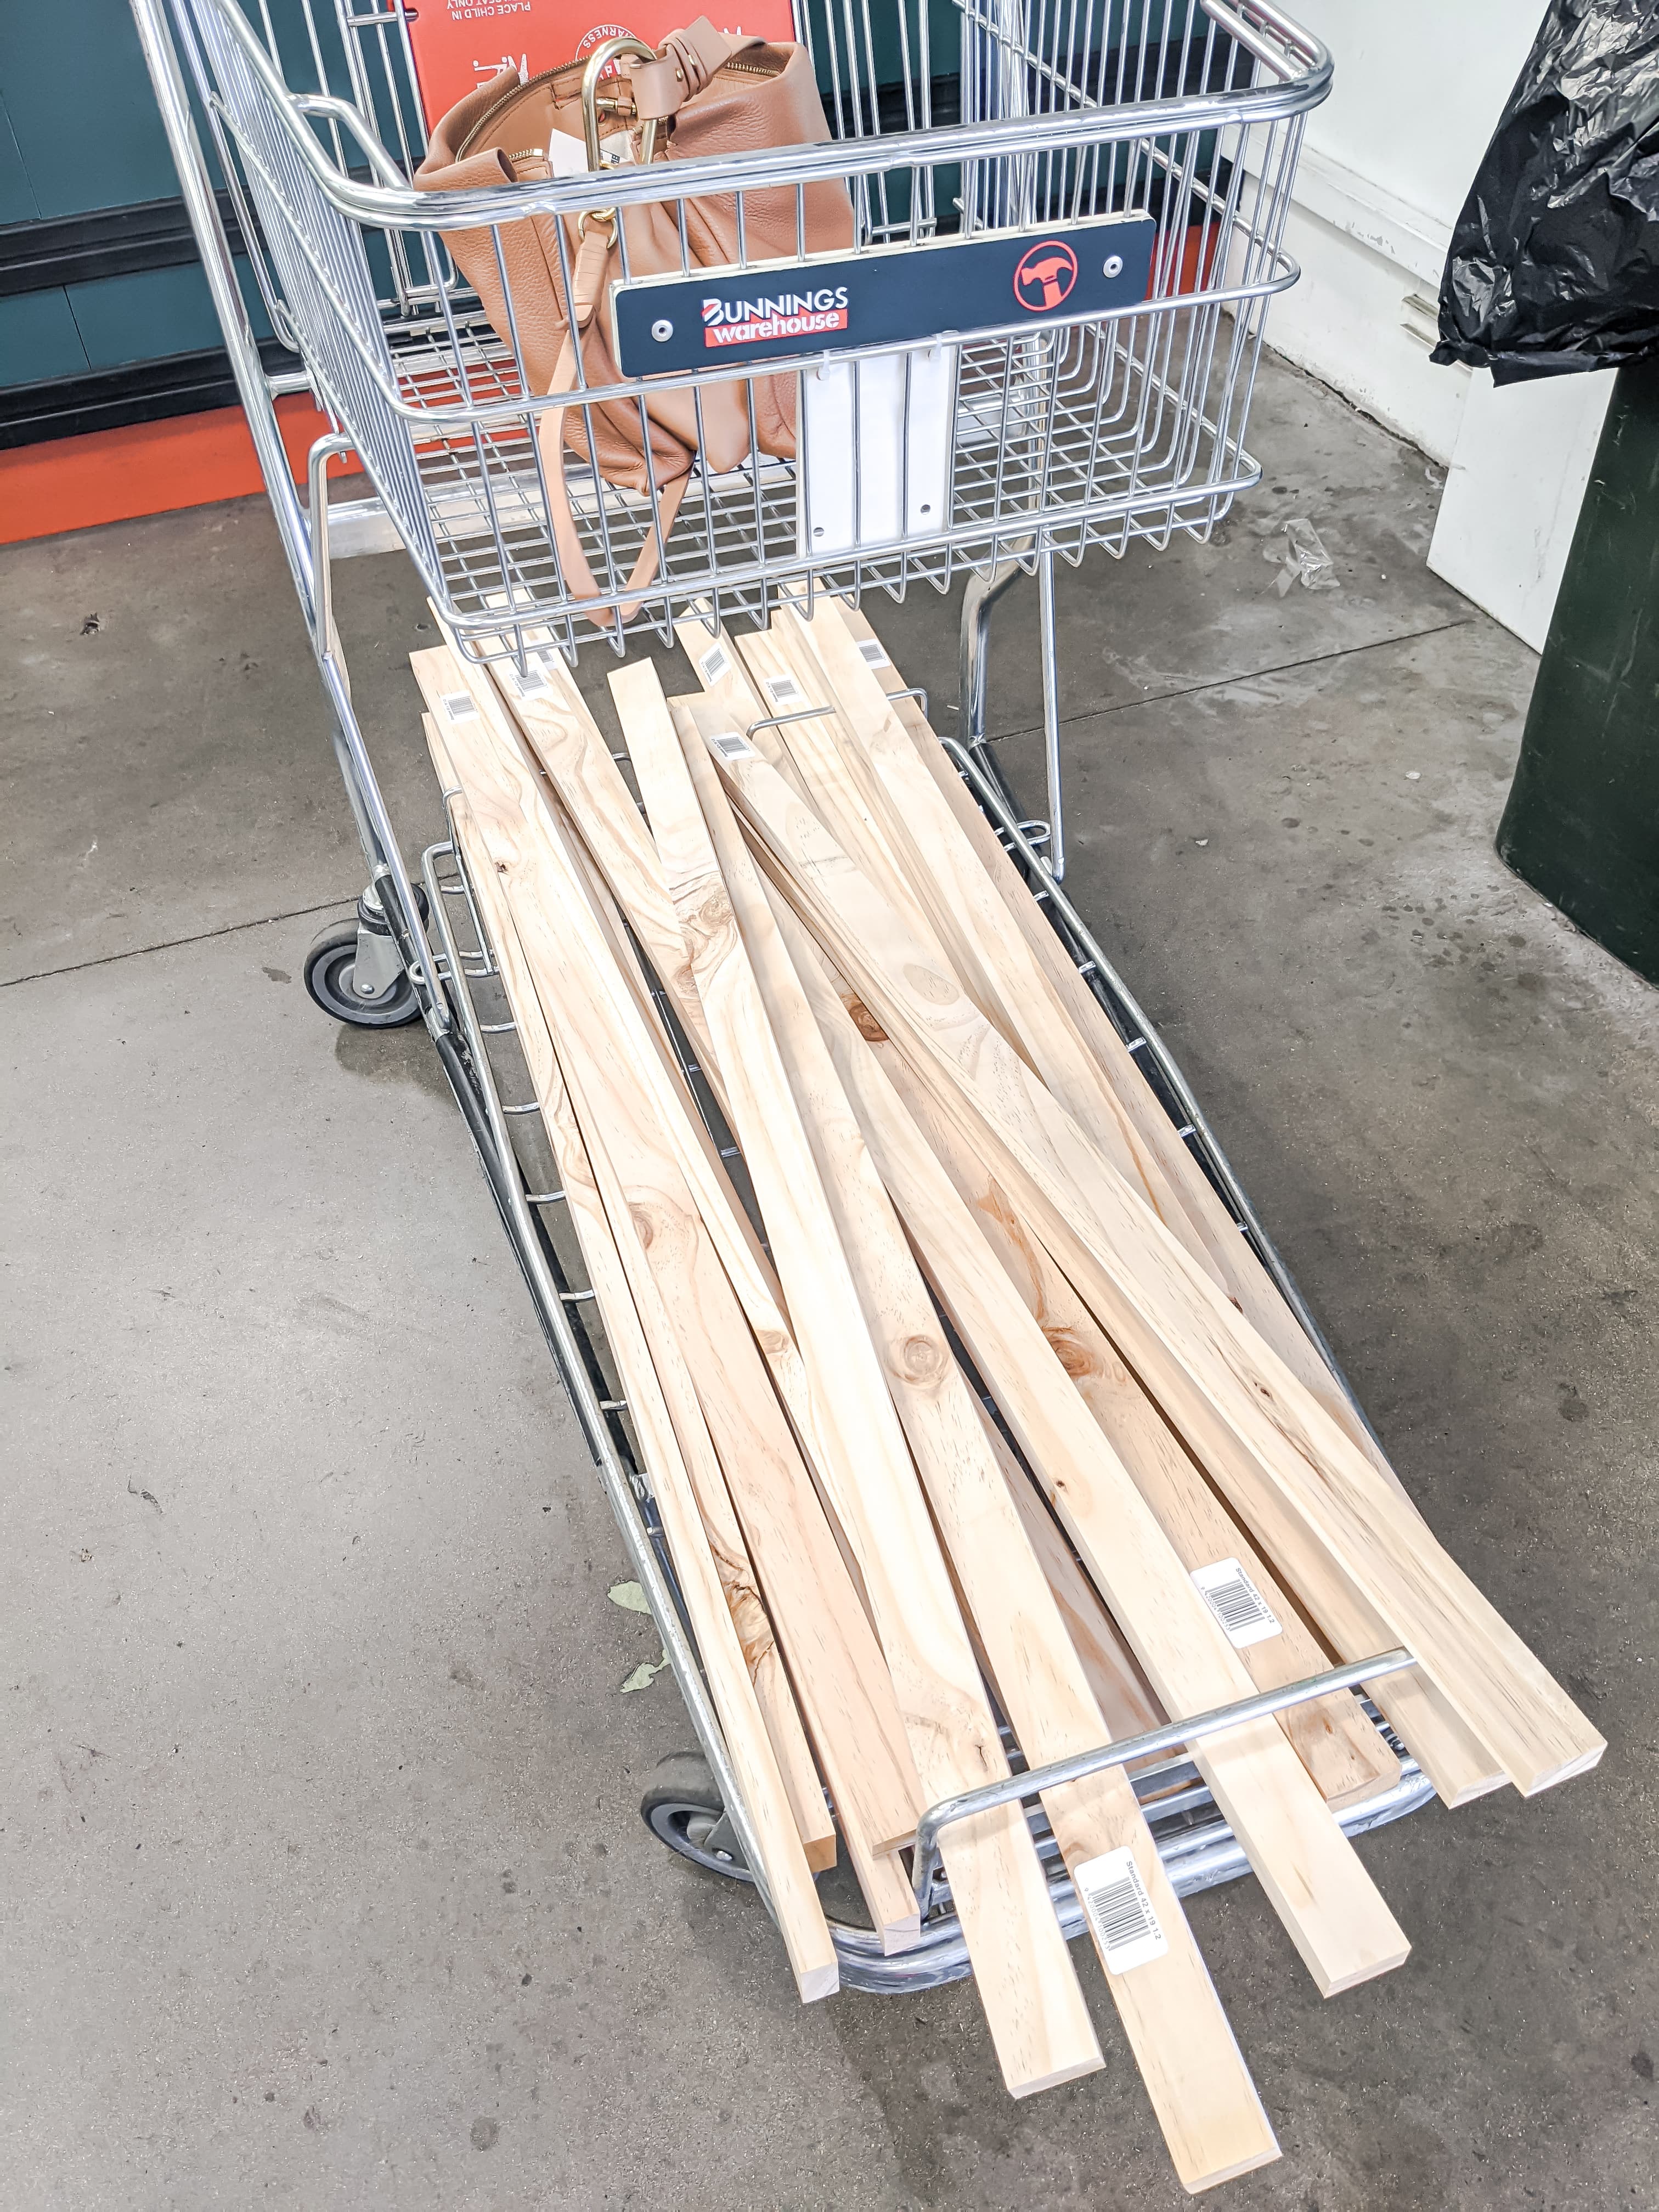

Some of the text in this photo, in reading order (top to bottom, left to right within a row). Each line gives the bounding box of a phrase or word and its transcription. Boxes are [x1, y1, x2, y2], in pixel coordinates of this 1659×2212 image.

[452, 1, 531, 21] PLACE CHILD IN
[583, 26, 632, 48] ARNESS
[702, 286, 848, 326] BUNNINGS
[713, 312, 840, 343] warehouse
[1235, 1567, 1255, 1592] Standard
[1126, 1860, 1144, 1895] Standard
[1141, 1898, 1148, 1908] 42
[1148, 1916, 1156, 1925] 19
[1153, 1928, 1161, 1940] 1.2
